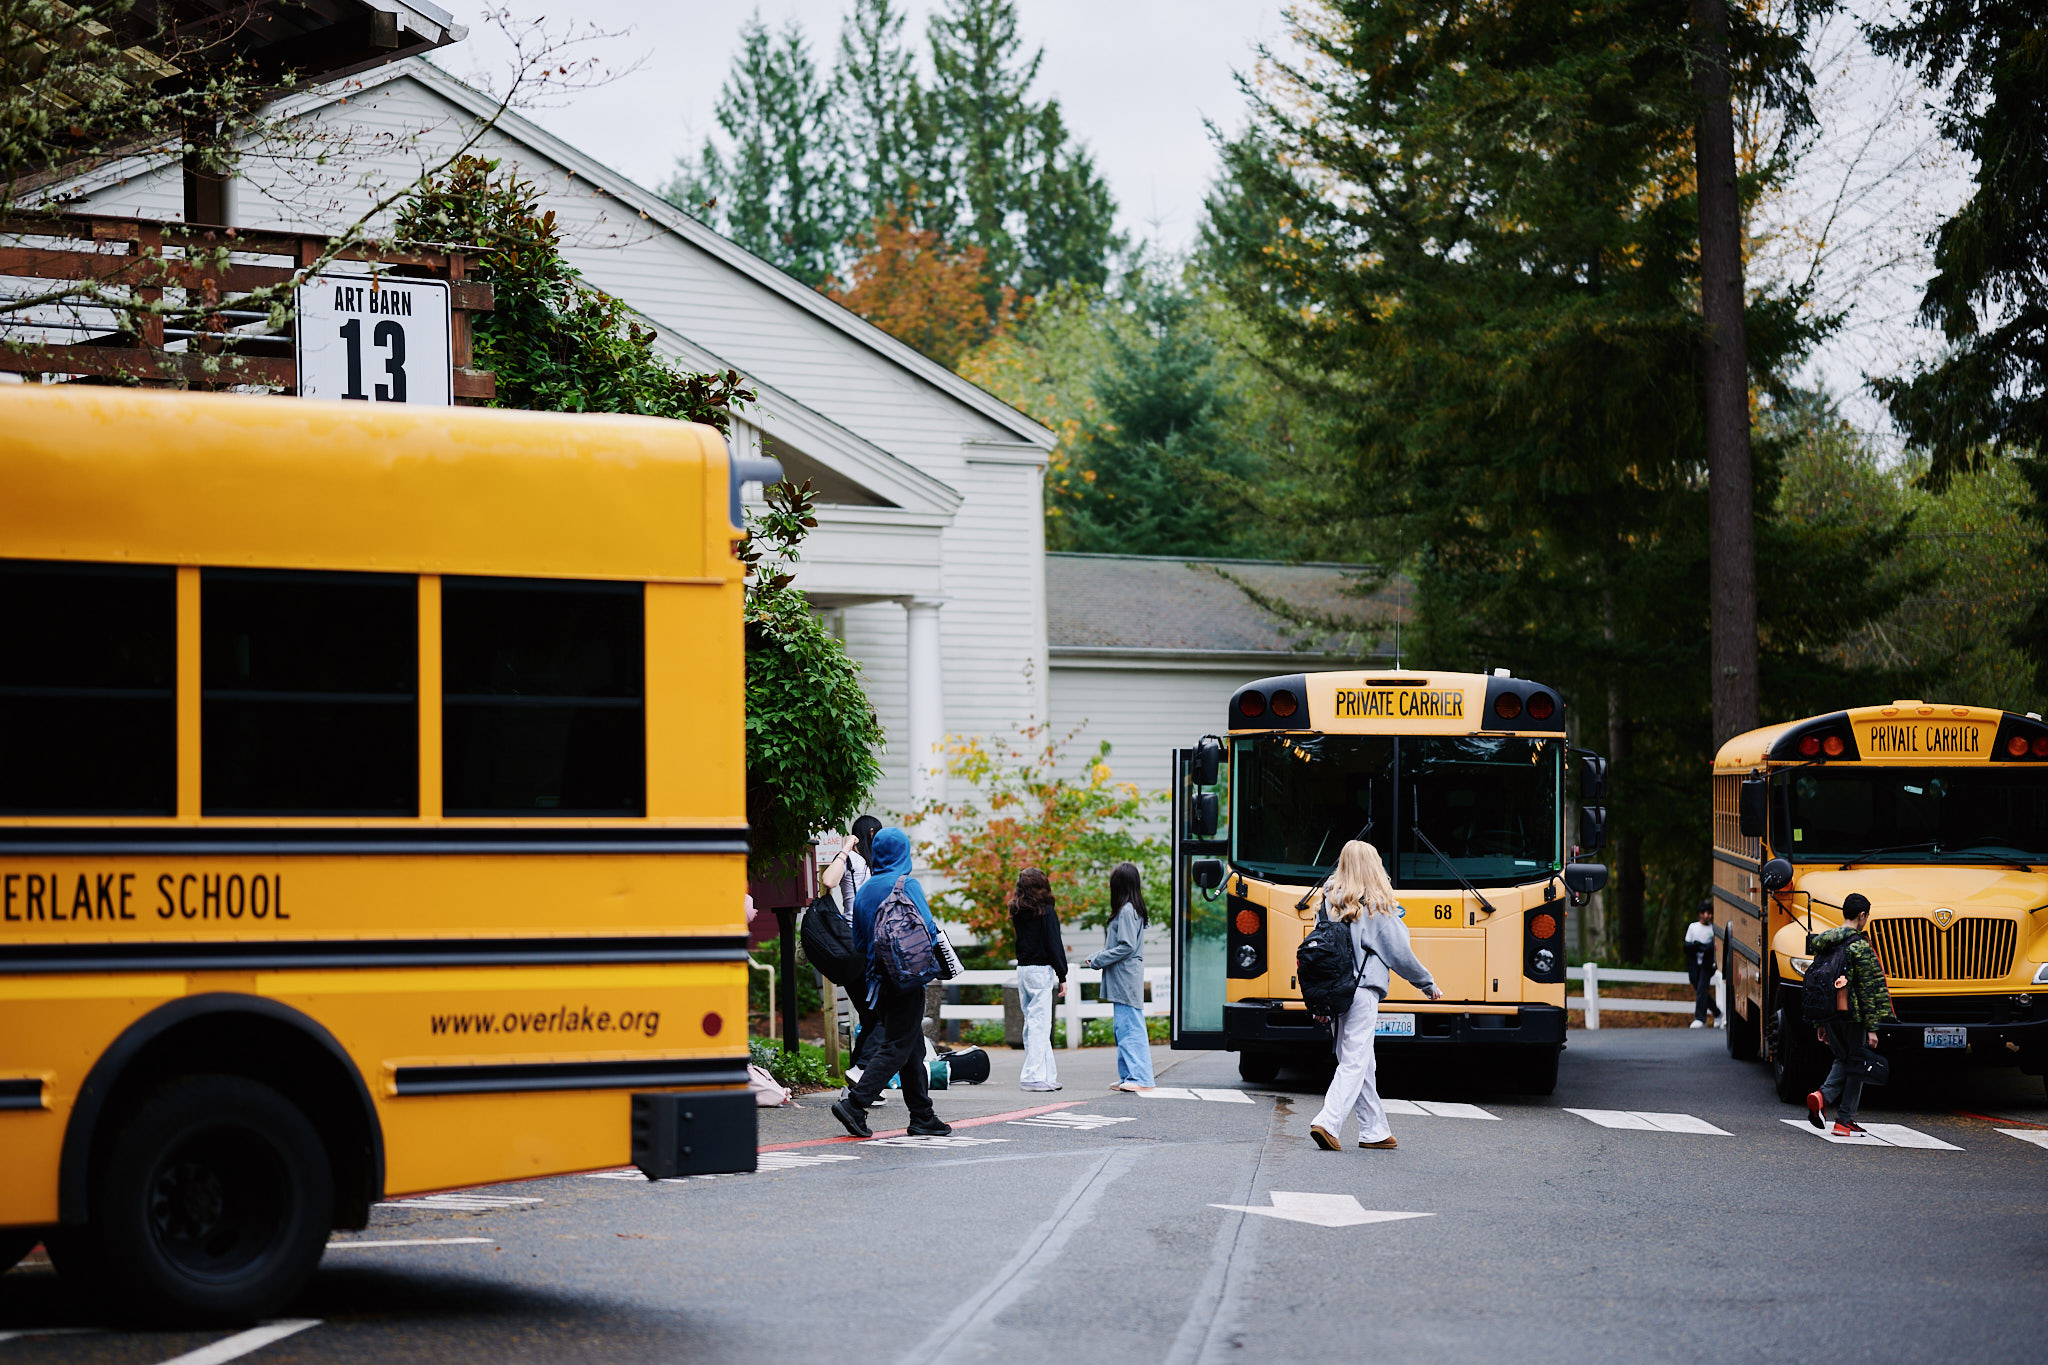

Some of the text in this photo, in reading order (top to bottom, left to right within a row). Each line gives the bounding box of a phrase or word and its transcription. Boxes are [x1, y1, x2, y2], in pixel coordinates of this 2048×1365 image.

[334, 285, 412, 317] ART BARN
[339, 318, 407, 403] 13
[1336, 691, 1463, 717] PRIVATE CARRIER
[1870, 725, 1979, 752] PRIVATE CARRIER
[0, 873, 291, 921] ERLAKE SCHOOL
[1433, 904, 1453, 920] 68
[430, 1004, 661, 1037] www.overlake.org
